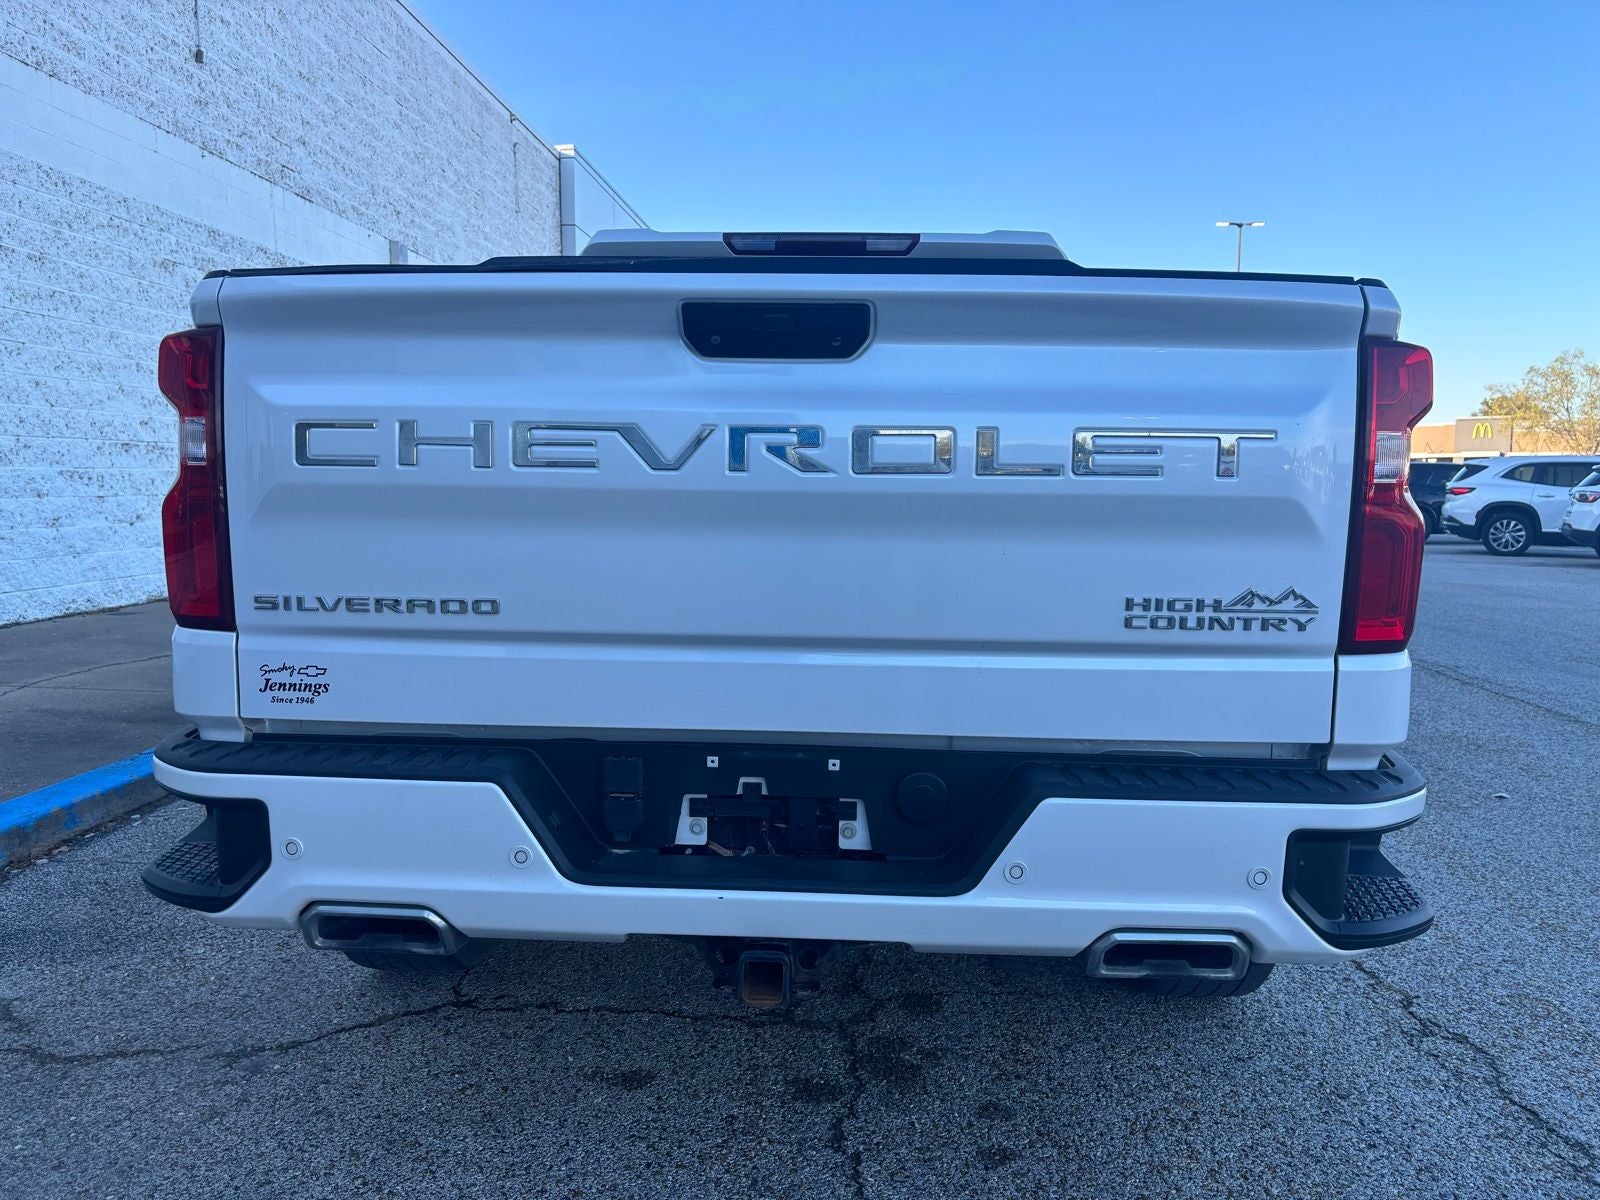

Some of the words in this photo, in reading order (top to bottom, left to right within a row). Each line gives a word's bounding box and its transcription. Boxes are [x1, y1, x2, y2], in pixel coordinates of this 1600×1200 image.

[294, 418, 1277, 478] CHEVROLET
[253, 594, 501, 615] SILVERADO
[1125, 596, 1223, 612] HIGH
[1124, 614, 1316, 632] COUNTRY
[259, 678, 330, 696] Jennings
[270, 695, 294, 704] Since
[295, 695, 315, 705] 1946
